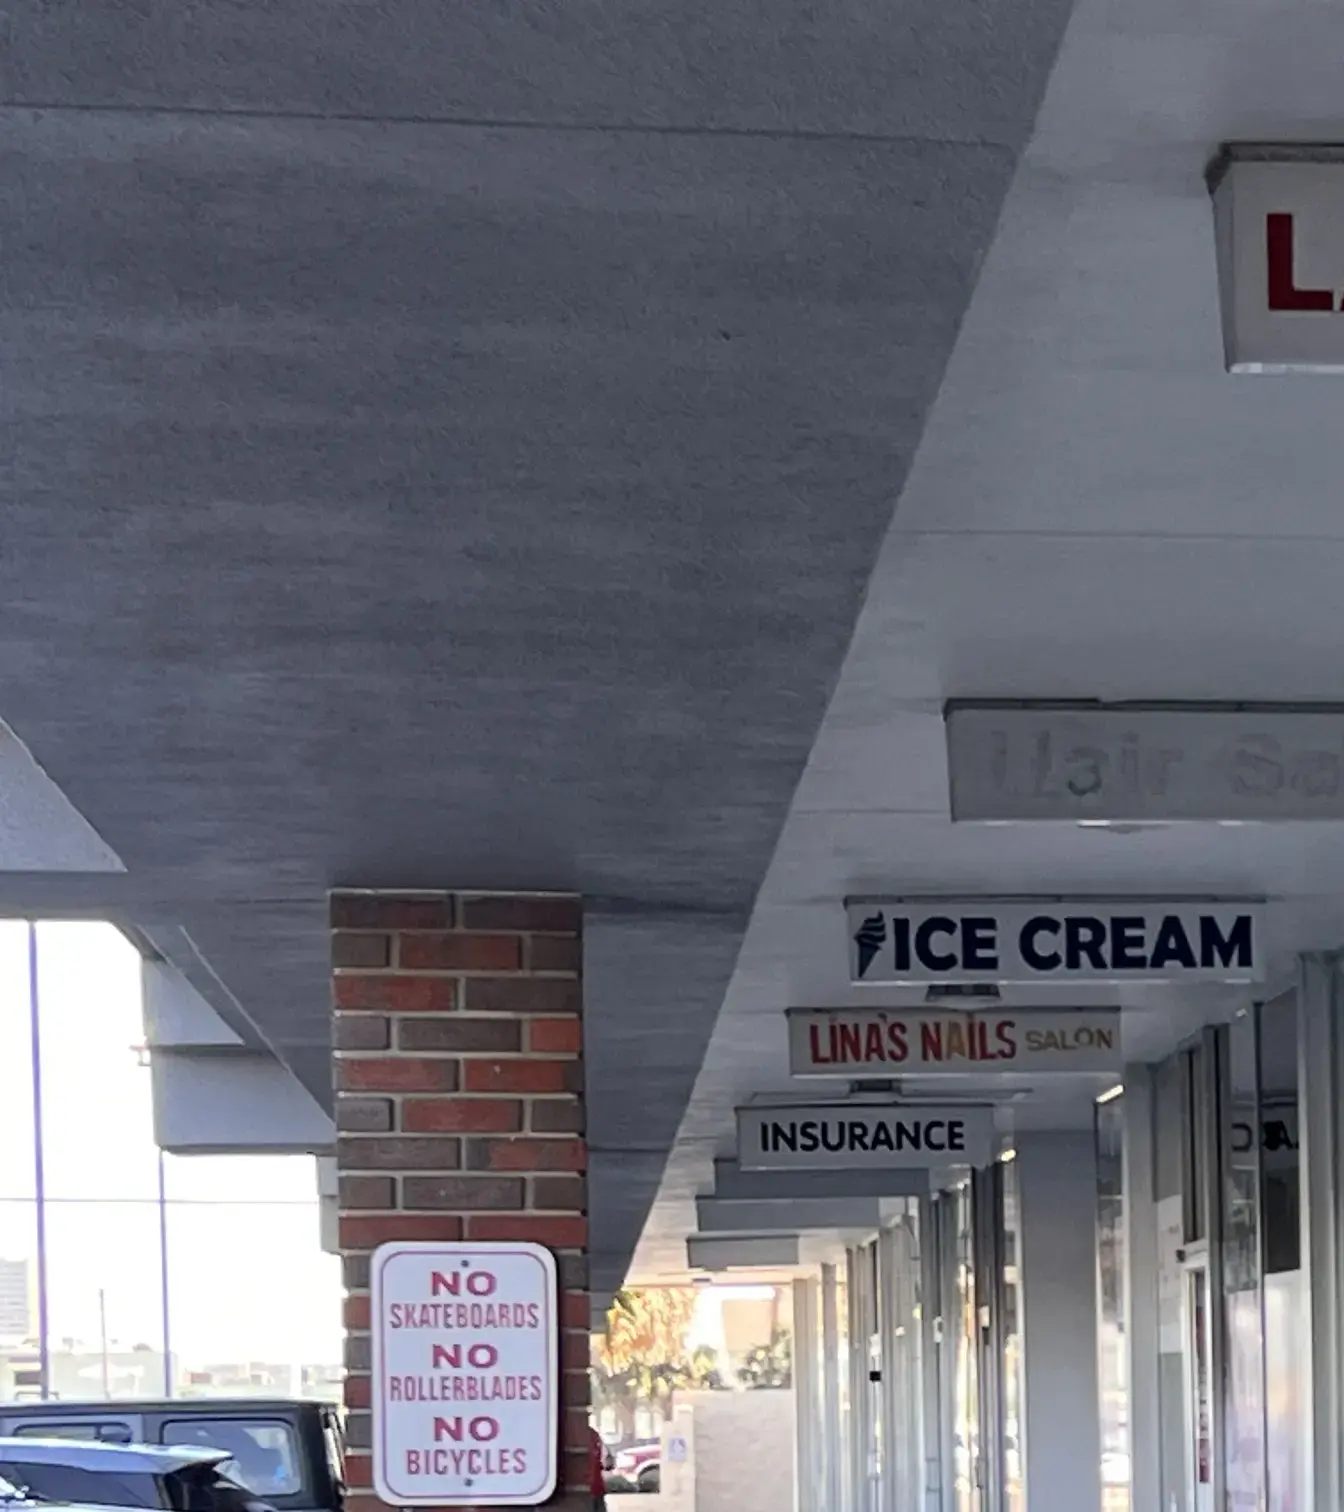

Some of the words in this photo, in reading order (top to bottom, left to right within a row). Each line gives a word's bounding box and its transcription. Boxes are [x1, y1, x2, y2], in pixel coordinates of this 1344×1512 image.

[894, 916, 999, 971] ICE
[1018, 914, 1254, 970] CREAM
[809, 1010, 910, 1066] LINA'S
[919, 1011, 1018, 1062] NAILS
[1026, 1027, 1114, 1053] SALON
[760, 1119, 967, 1153] INSURANCE
[430, 1270, 498, 1297] NO
[389, 1303, 540, 1329] SKATEBOARDS
[432, 1343, 499, 1369] NO
[389, 1375, 543, 1402] ROLLERBLADES
[433, 1416, 500, 1442] NO
[405, 1448, 527, 1476] BICYCLES
